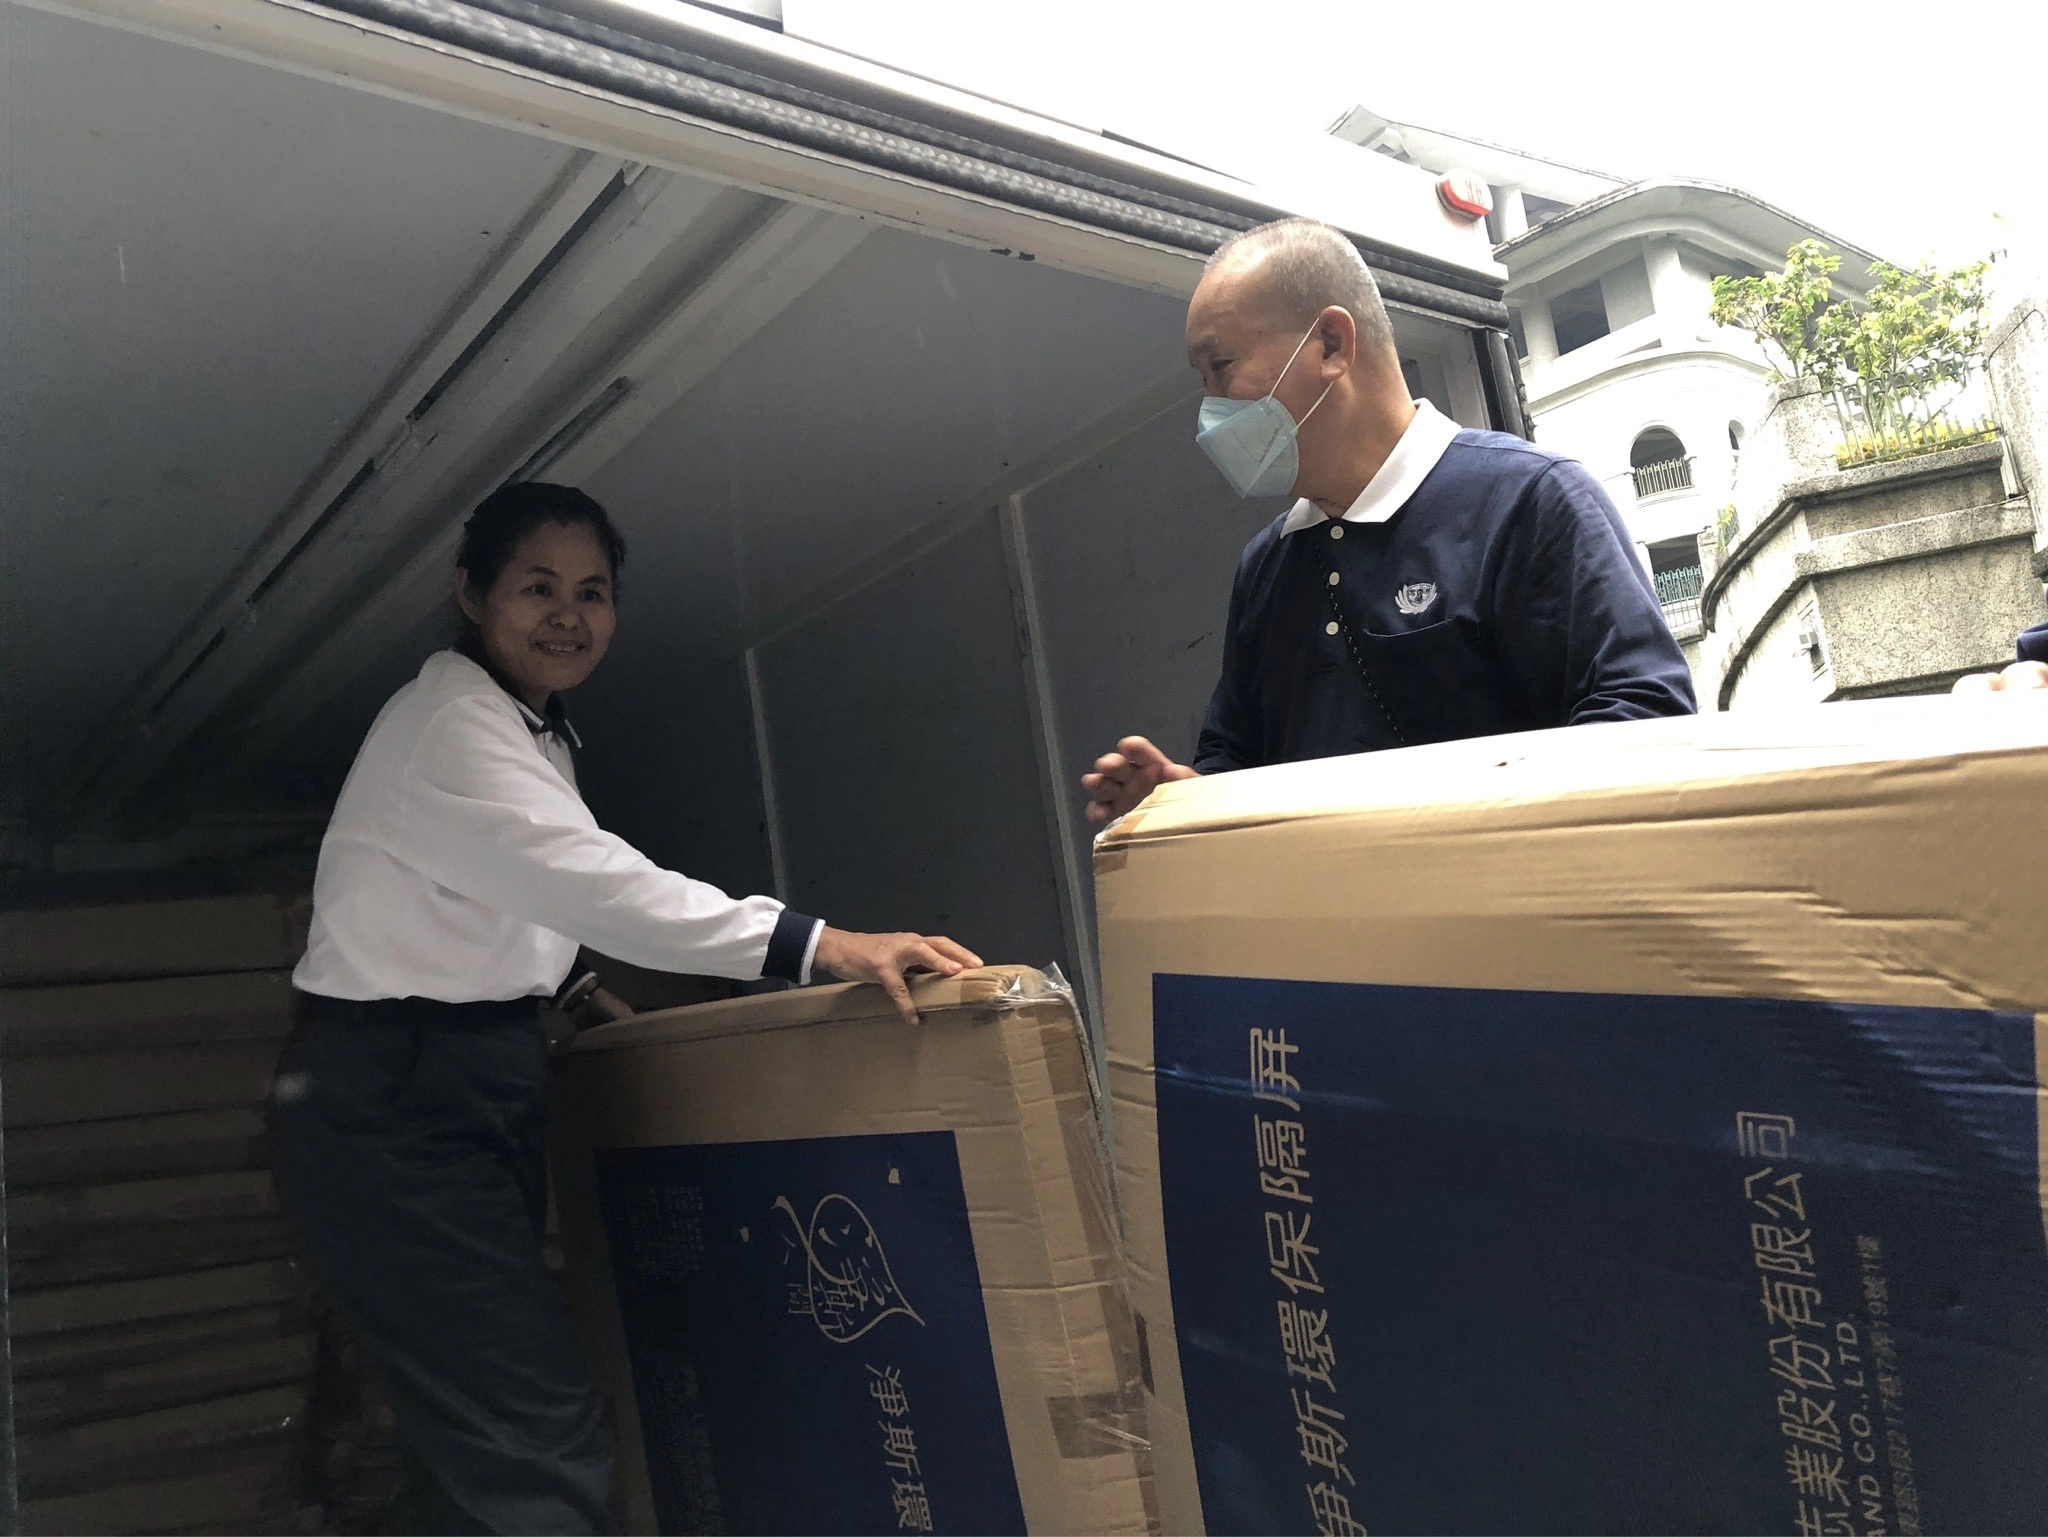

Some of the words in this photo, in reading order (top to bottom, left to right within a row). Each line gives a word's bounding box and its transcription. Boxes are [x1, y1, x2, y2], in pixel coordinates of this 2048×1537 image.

[864, 1362, 934, 1532] 淨斯環
[1735, 1110, 1856, 1537] 志業股份有限公司
